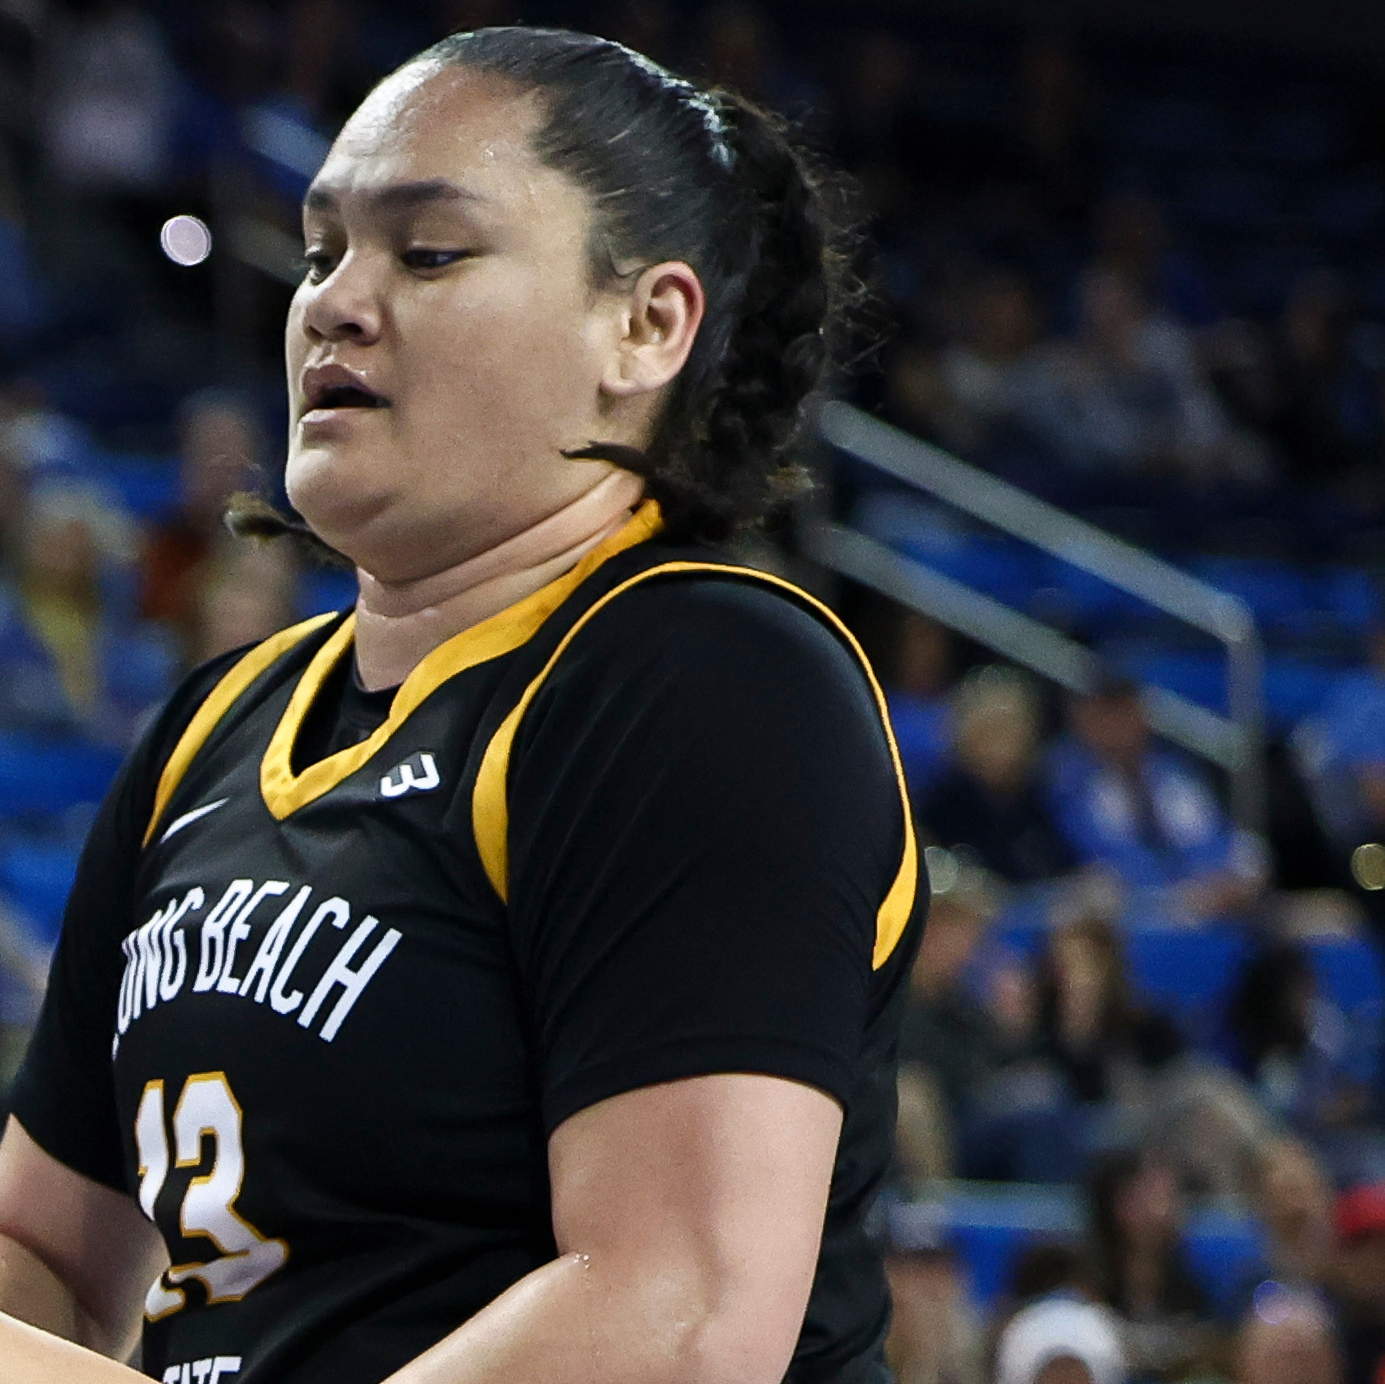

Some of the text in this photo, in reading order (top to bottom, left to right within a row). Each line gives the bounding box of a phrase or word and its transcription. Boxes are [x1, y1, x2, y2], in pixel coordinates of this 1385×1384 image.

[112, 879, 402, 1061] ONG BEACH
[134, 1071, 289, 1323] 13
